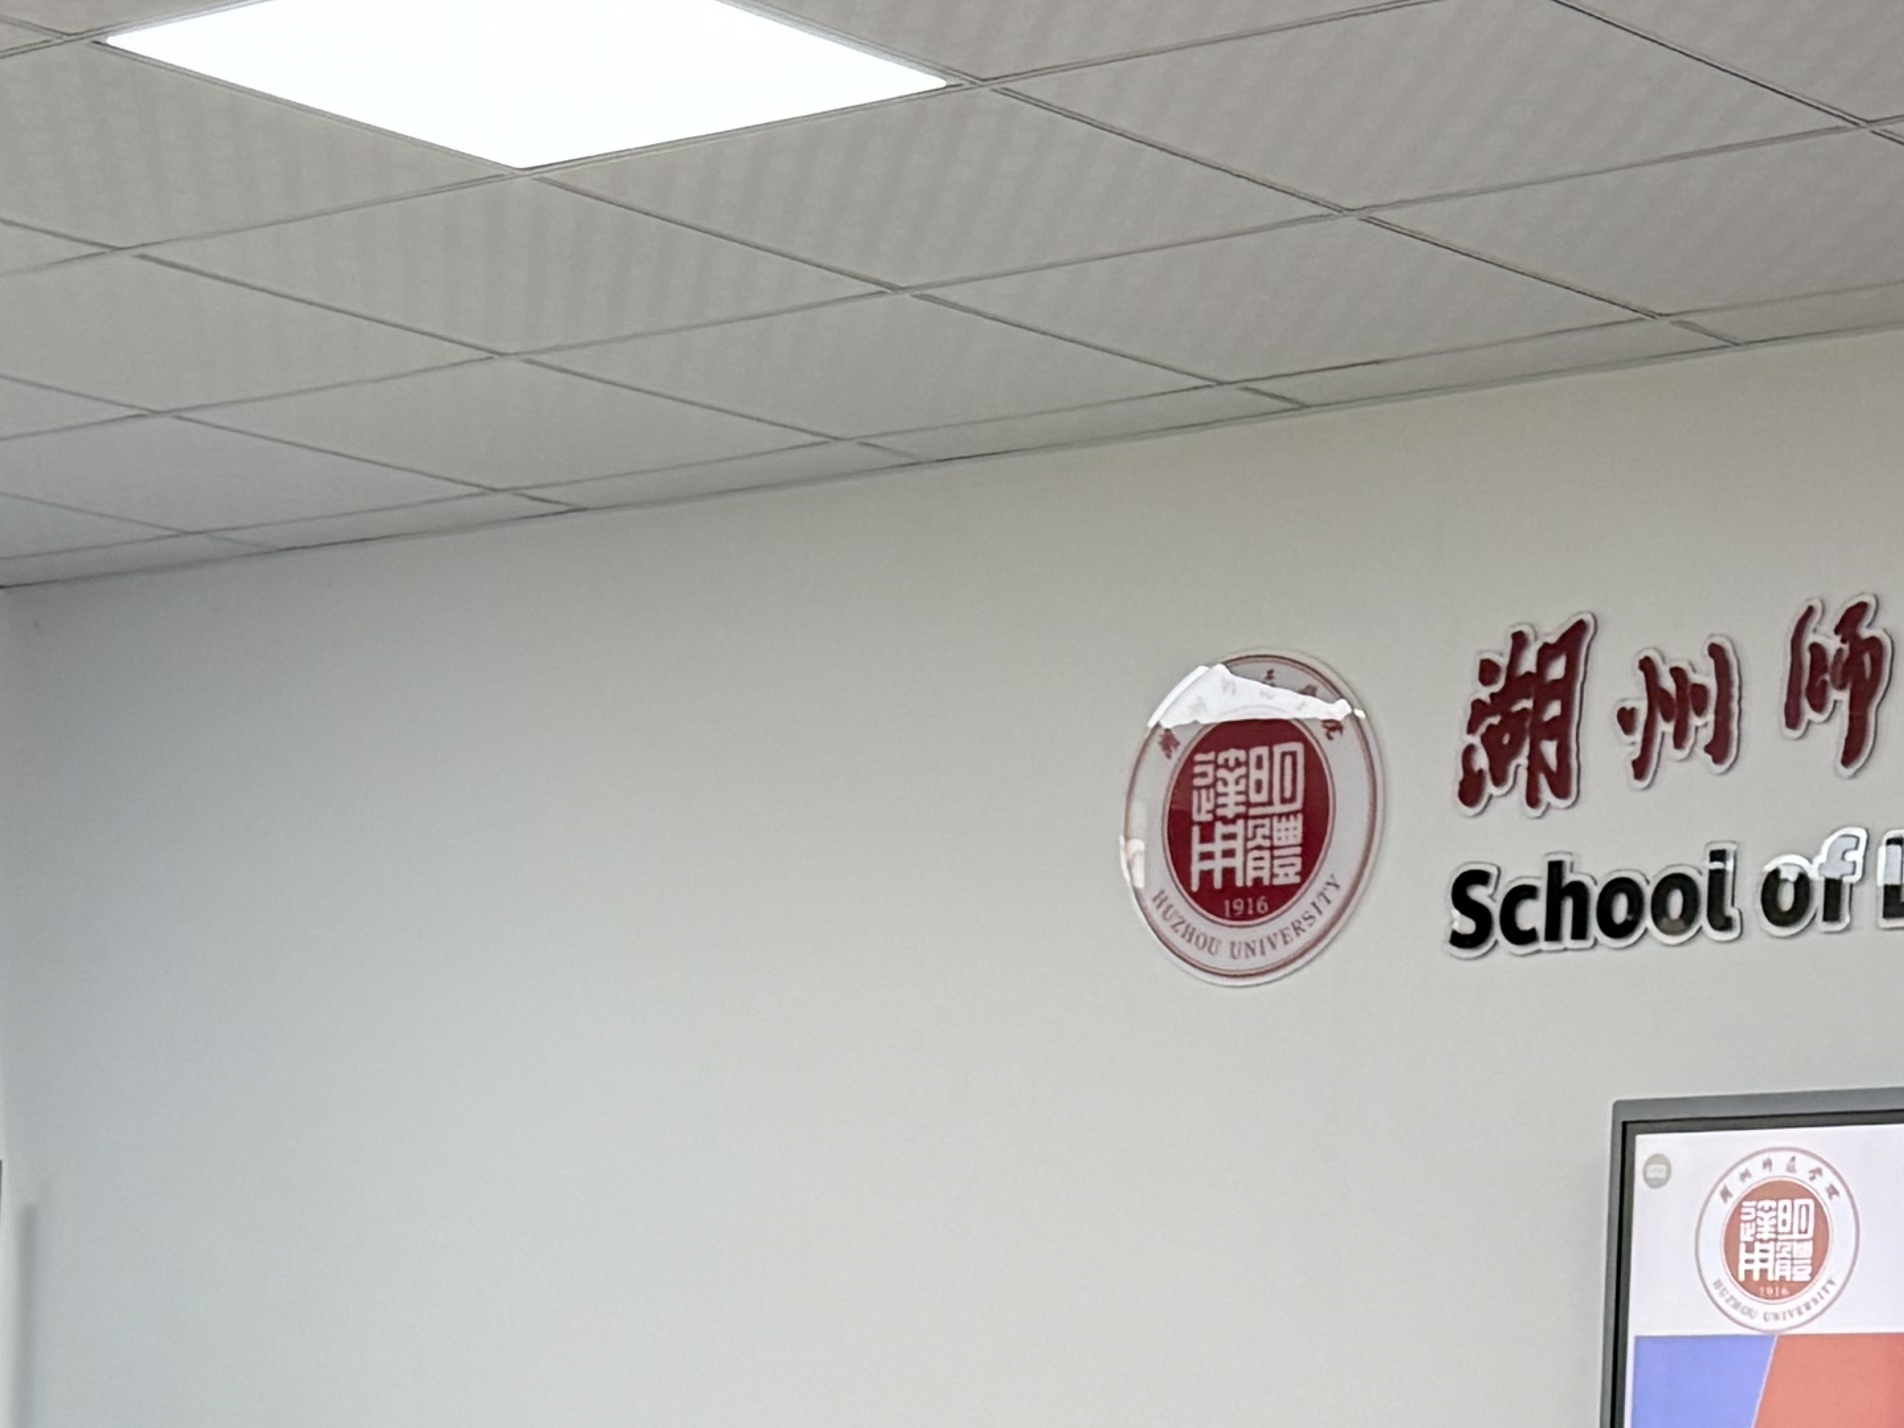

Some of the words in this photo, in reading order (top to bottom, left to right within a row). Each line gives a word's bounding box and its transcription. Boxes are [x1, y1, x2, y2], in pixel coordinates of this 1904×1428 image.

[1152, 889, 1221, 956] HUZHOU
[1229, 873, 1342, 960] UNIVERSITY
[1223, 898, 1270, 918] 1916
[1449, 846, 1734, 948] School
[1761, 832, 1862, 928] of
